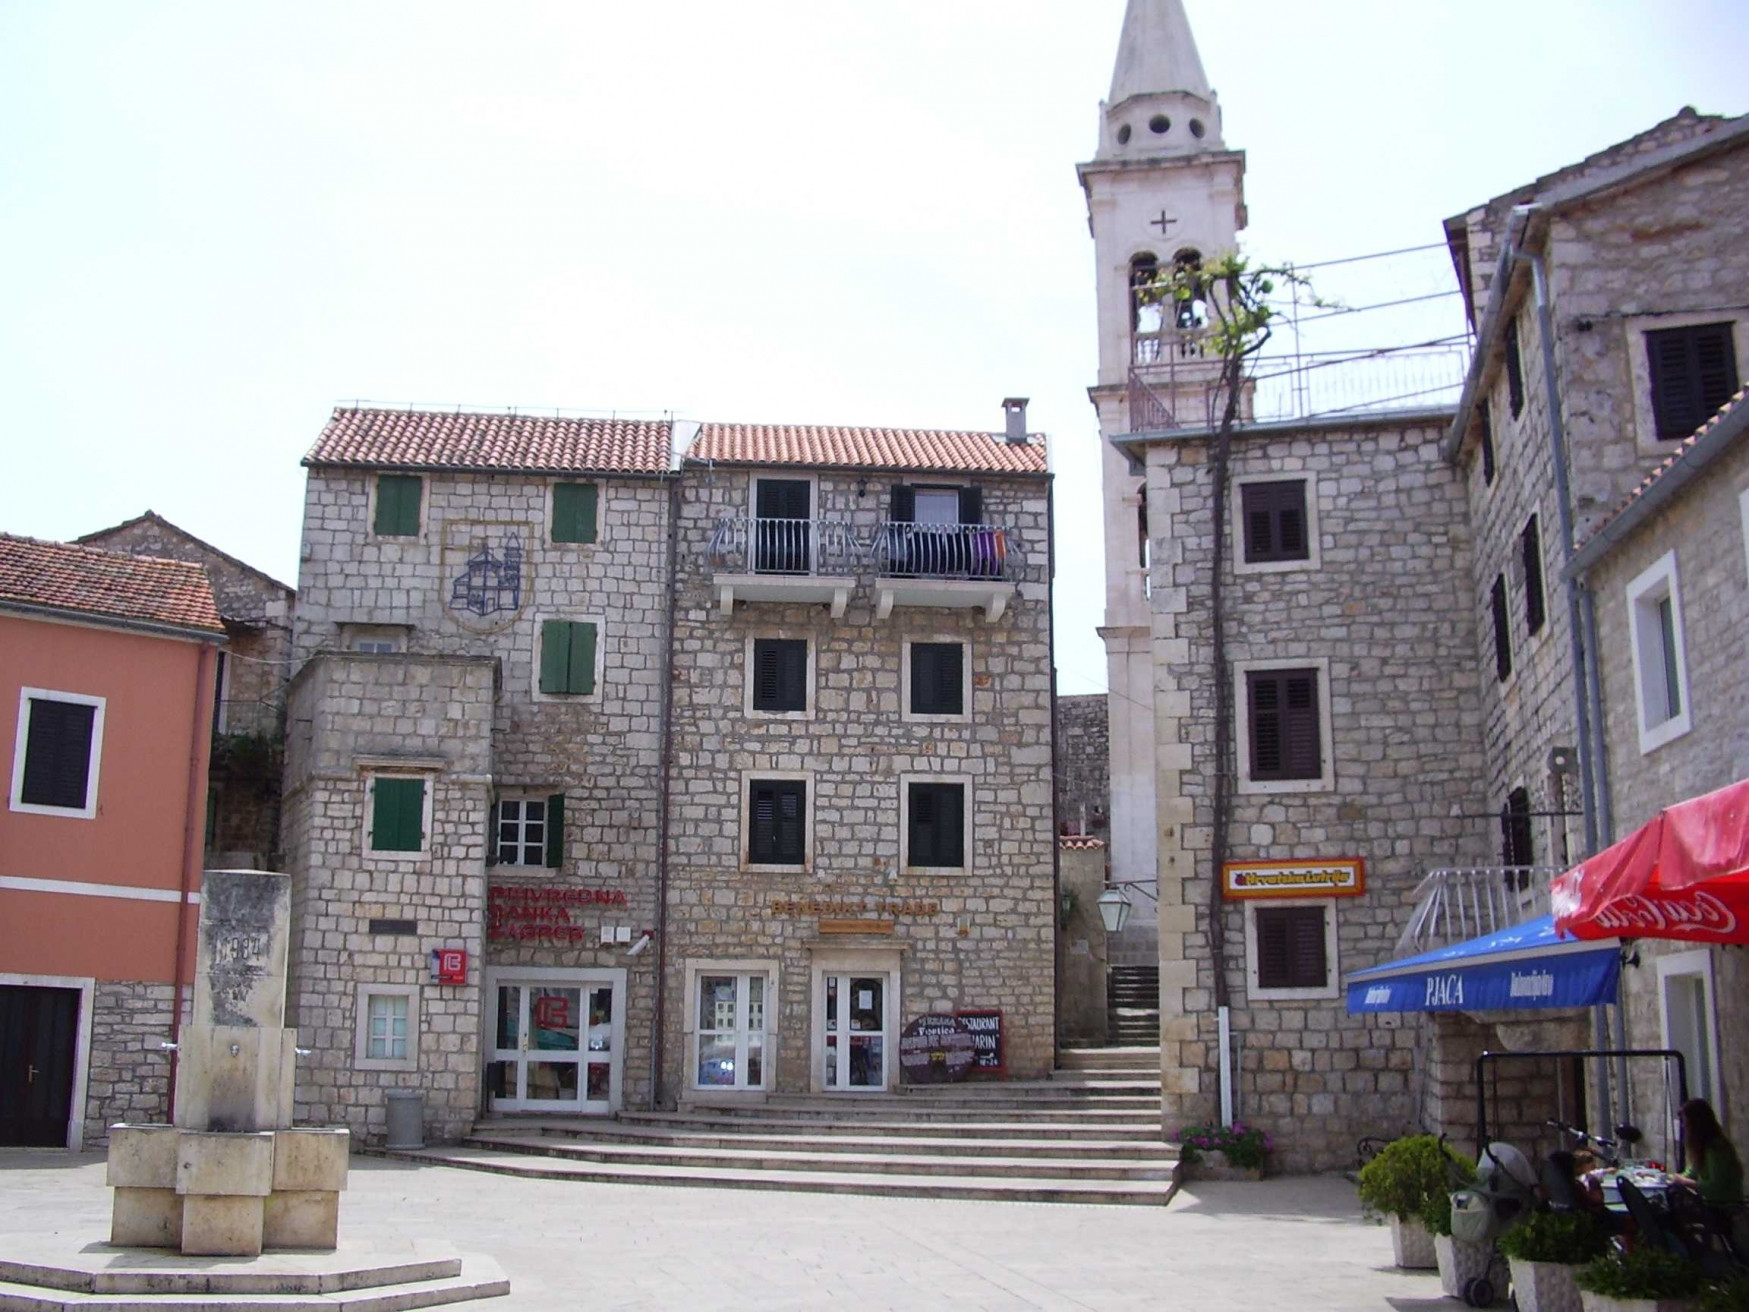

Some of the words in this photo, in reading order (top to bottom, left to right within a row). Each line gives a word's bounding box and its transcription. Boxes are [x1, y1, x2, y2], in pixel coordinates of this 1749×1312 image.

[1245, 871, 1305, 886] Hrvatska
[1306, 869, 1351, 886] Lutrija
[488, 886, 628, 906] PRIVREDNA
[488, 904, 571, 923] BANKA
[875, 902, 938, 917] TRADE
[488, 923, 586, 941] ZAGREB
[1424, 973, 1464, 1007] PJACA
